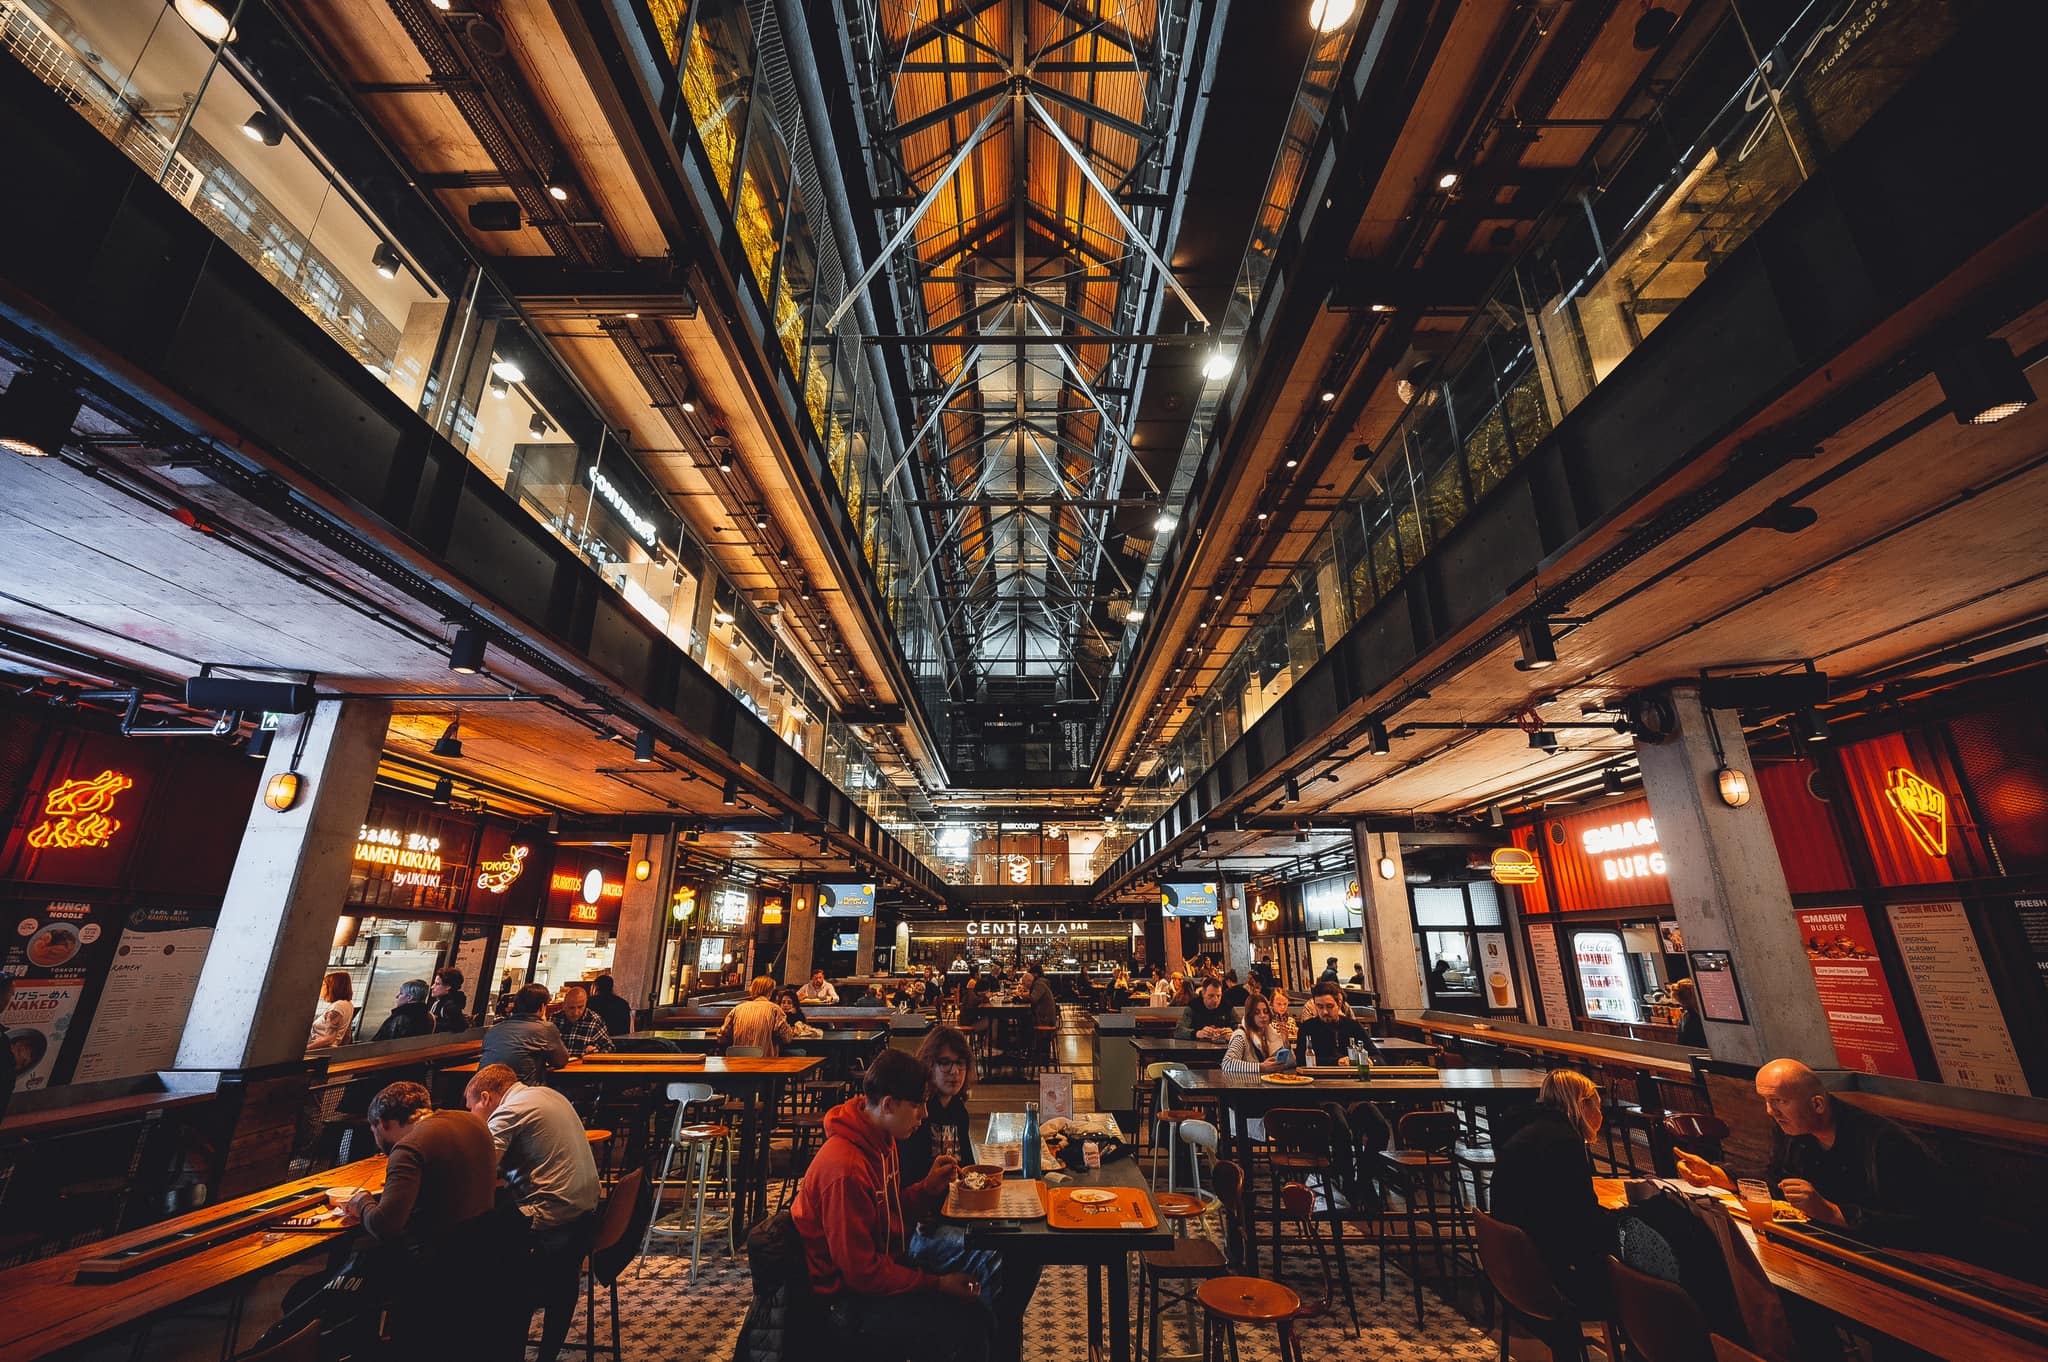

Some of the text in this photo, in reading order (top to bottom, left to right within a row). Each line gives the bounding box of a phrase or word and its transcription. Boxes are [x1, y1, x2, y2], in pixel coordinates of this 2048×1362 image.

[1820, 14, 1877, 76] HOME AND
[400, 850, 441, 871] KIKUYA
[481, 861, 510, 871] TOKYO
[392, 869, 441, 887] by UKIUKI
[48, 902, 90, 912] LUNCH
[2014, 900, 2048, 908] FRESH
[967, 922, 1068, 935] CENTRALA
[1810, 923, 1846, 932] BURGER
[8, 1000, 59, 1010] NAKED
